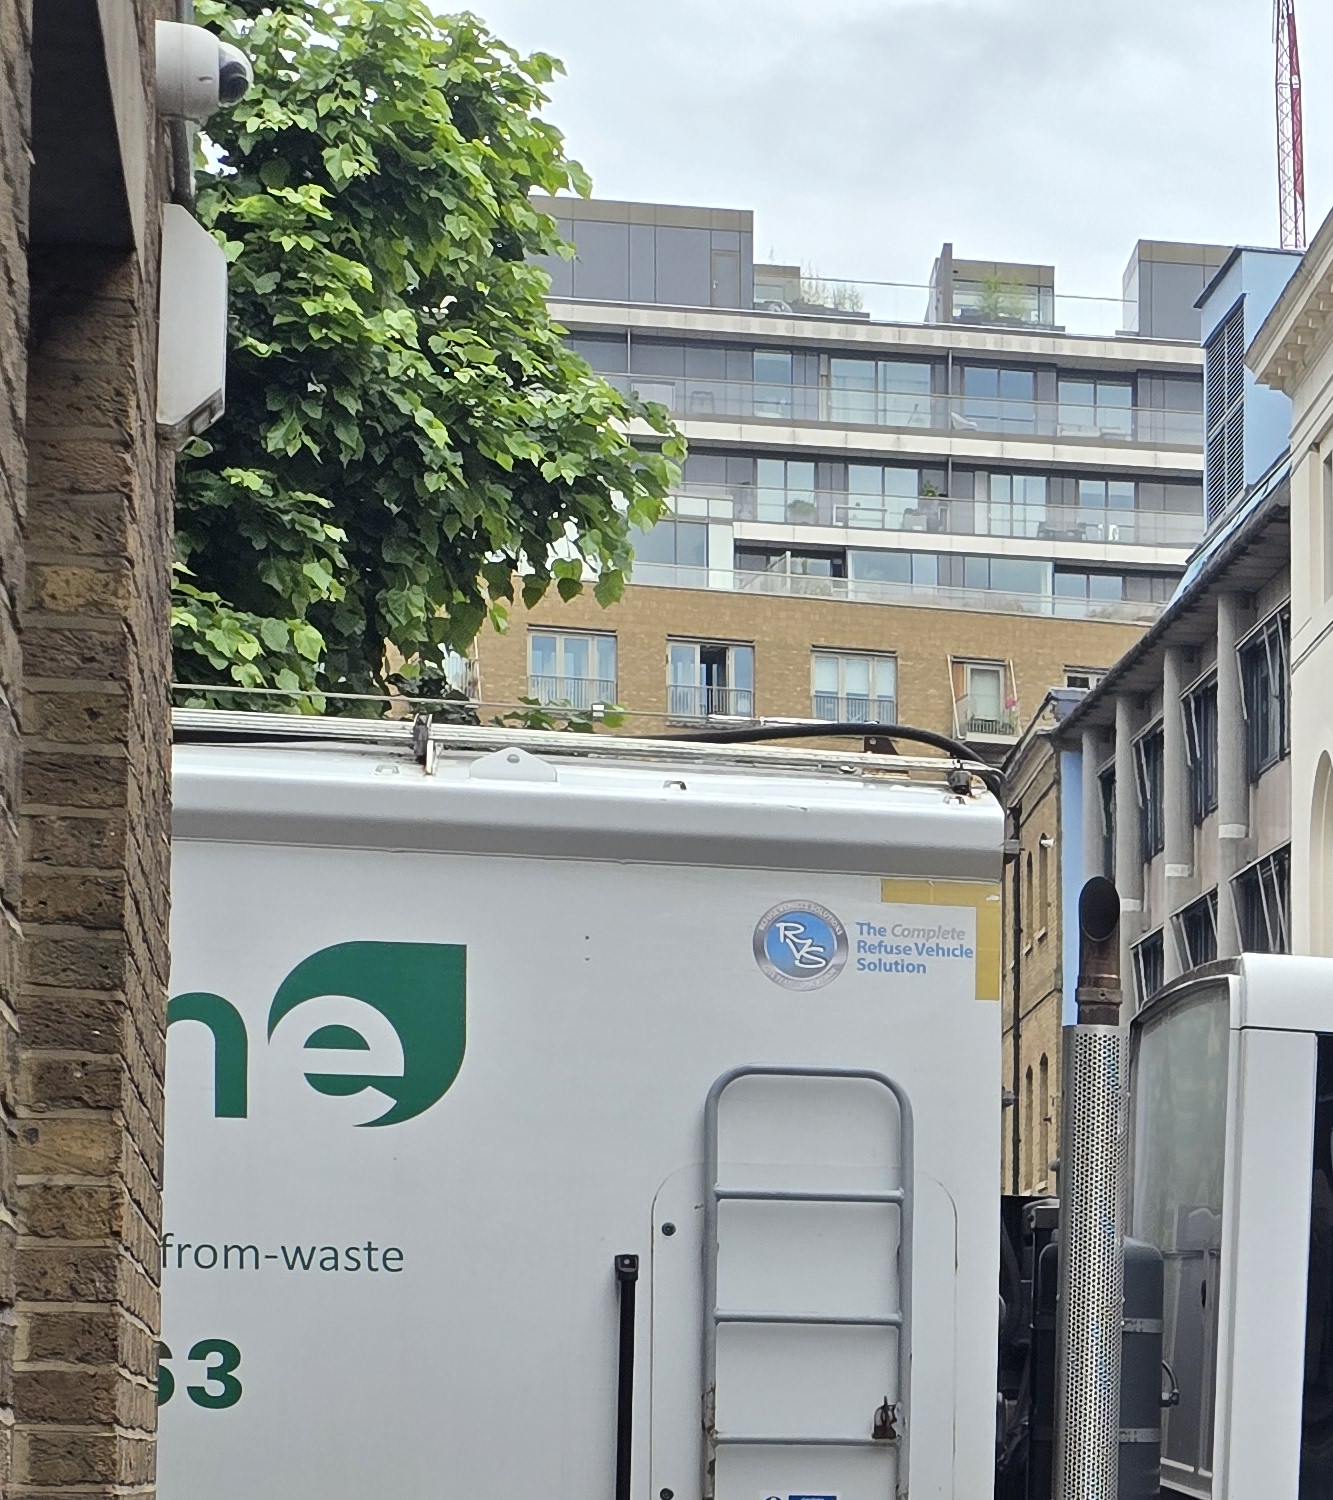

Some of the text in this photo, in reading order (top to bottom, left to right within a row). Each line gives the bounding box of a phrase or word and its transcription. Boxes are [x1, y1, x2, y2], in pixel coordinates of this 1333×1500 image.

[855, 922, 966, 942] The Complete
[857, 940, 974, 959] Refuse Vehicle
[856, 957, 927, 974] Solution
